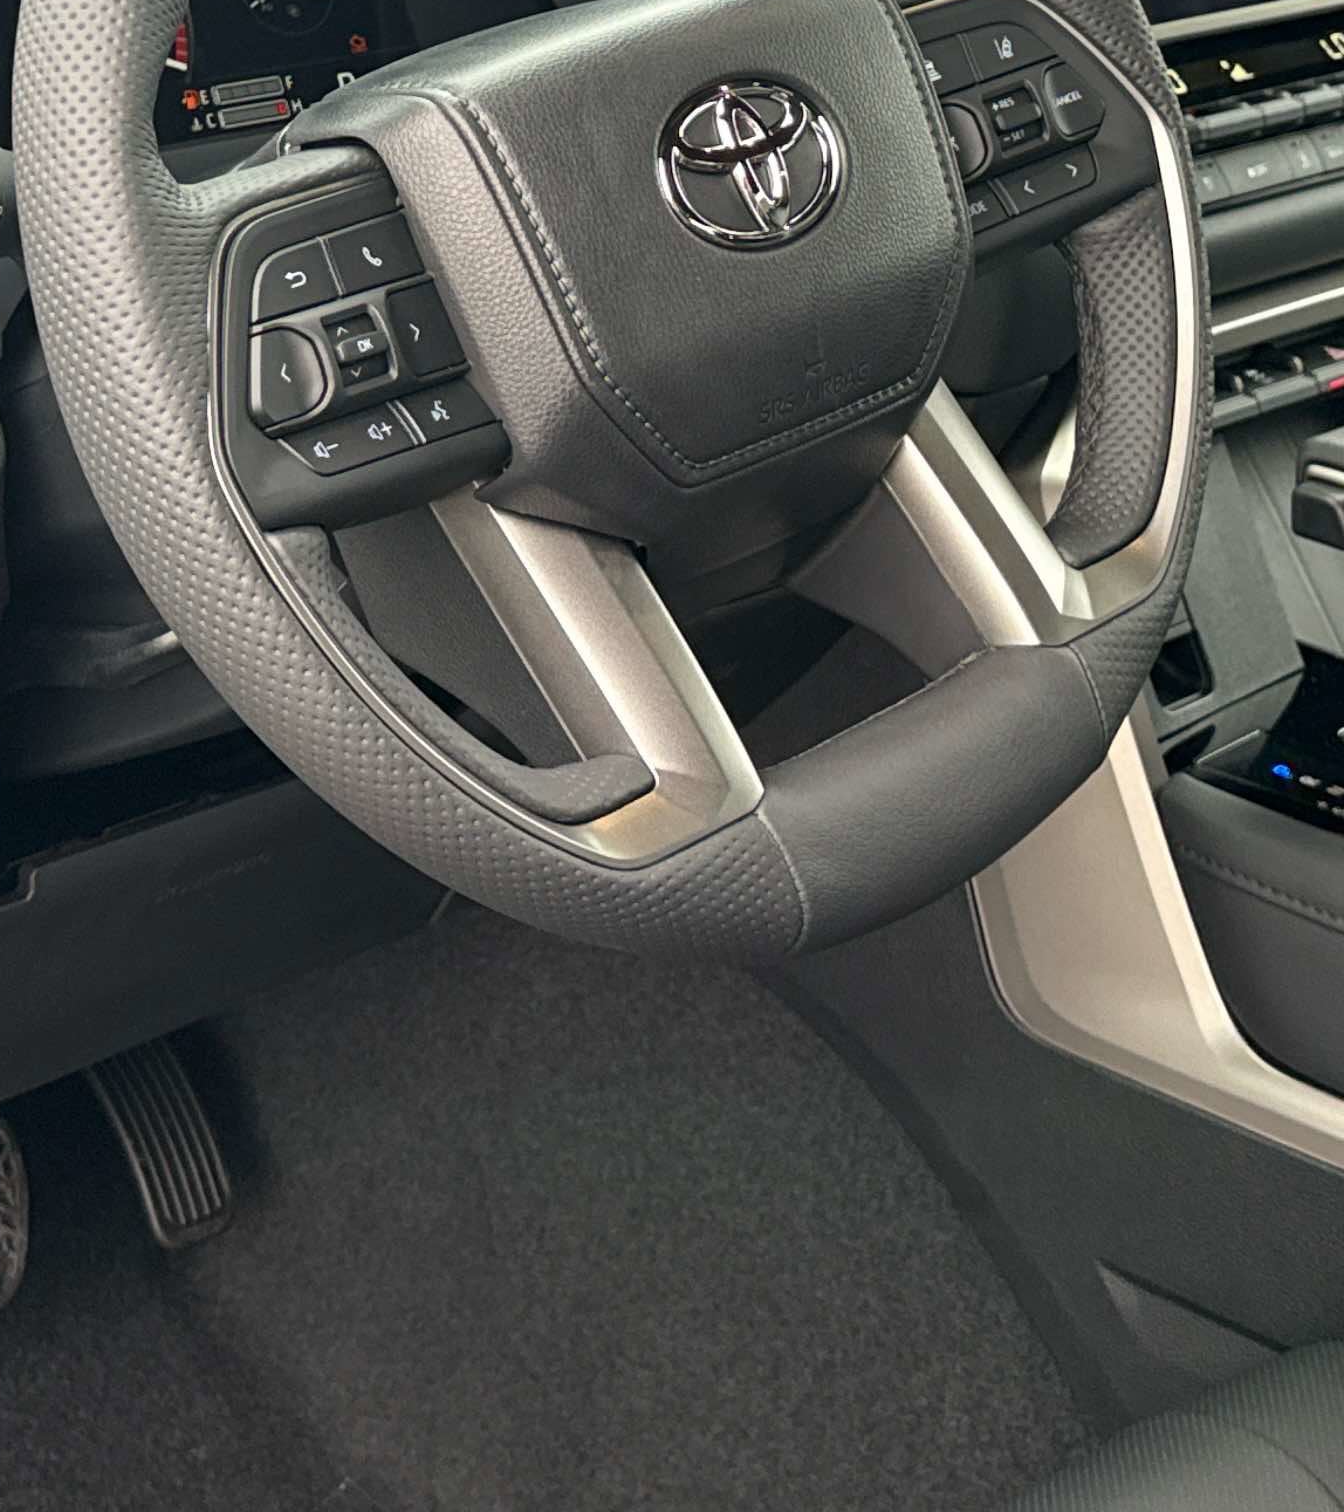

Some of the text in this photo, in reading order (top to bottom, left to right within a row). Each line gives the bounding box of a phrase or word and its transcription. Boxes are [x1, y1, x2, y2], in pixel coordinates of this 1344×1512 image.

[200, 89, 210, 105] E
[206, 113, 217, 128] C
[356, 338, 374, 352] OK
